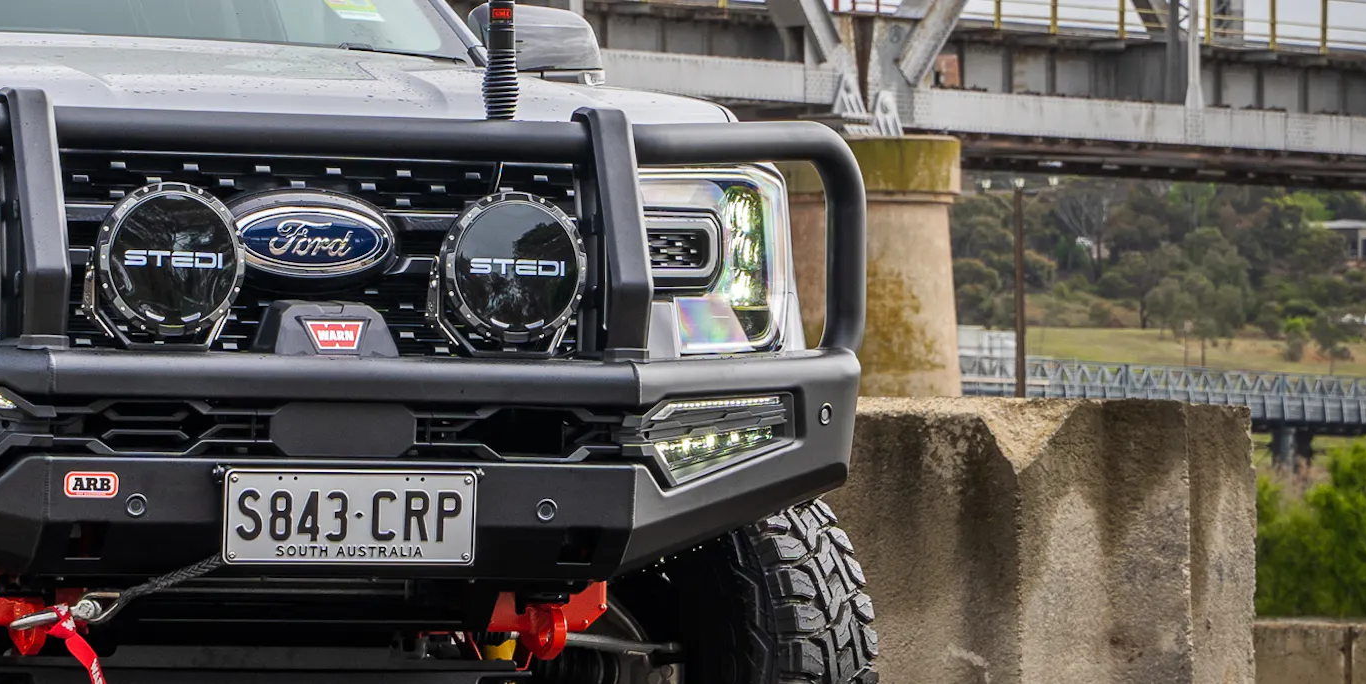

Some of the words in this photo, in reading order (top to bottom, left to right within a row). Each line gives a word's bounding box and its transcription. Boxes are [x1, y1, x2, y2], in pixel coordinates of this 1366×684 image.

[269, 219, 354, 257] Ford
[124, 250, 223, 269] STEDI
[470, 258, 565, 277] STEDI
[317, 330, 355, 341] WARN
[72, 477, 111, 491] ARB
[276, 545, 328, 557] SOUTH
[336, 546, 424, 558] AUSTRALIA
